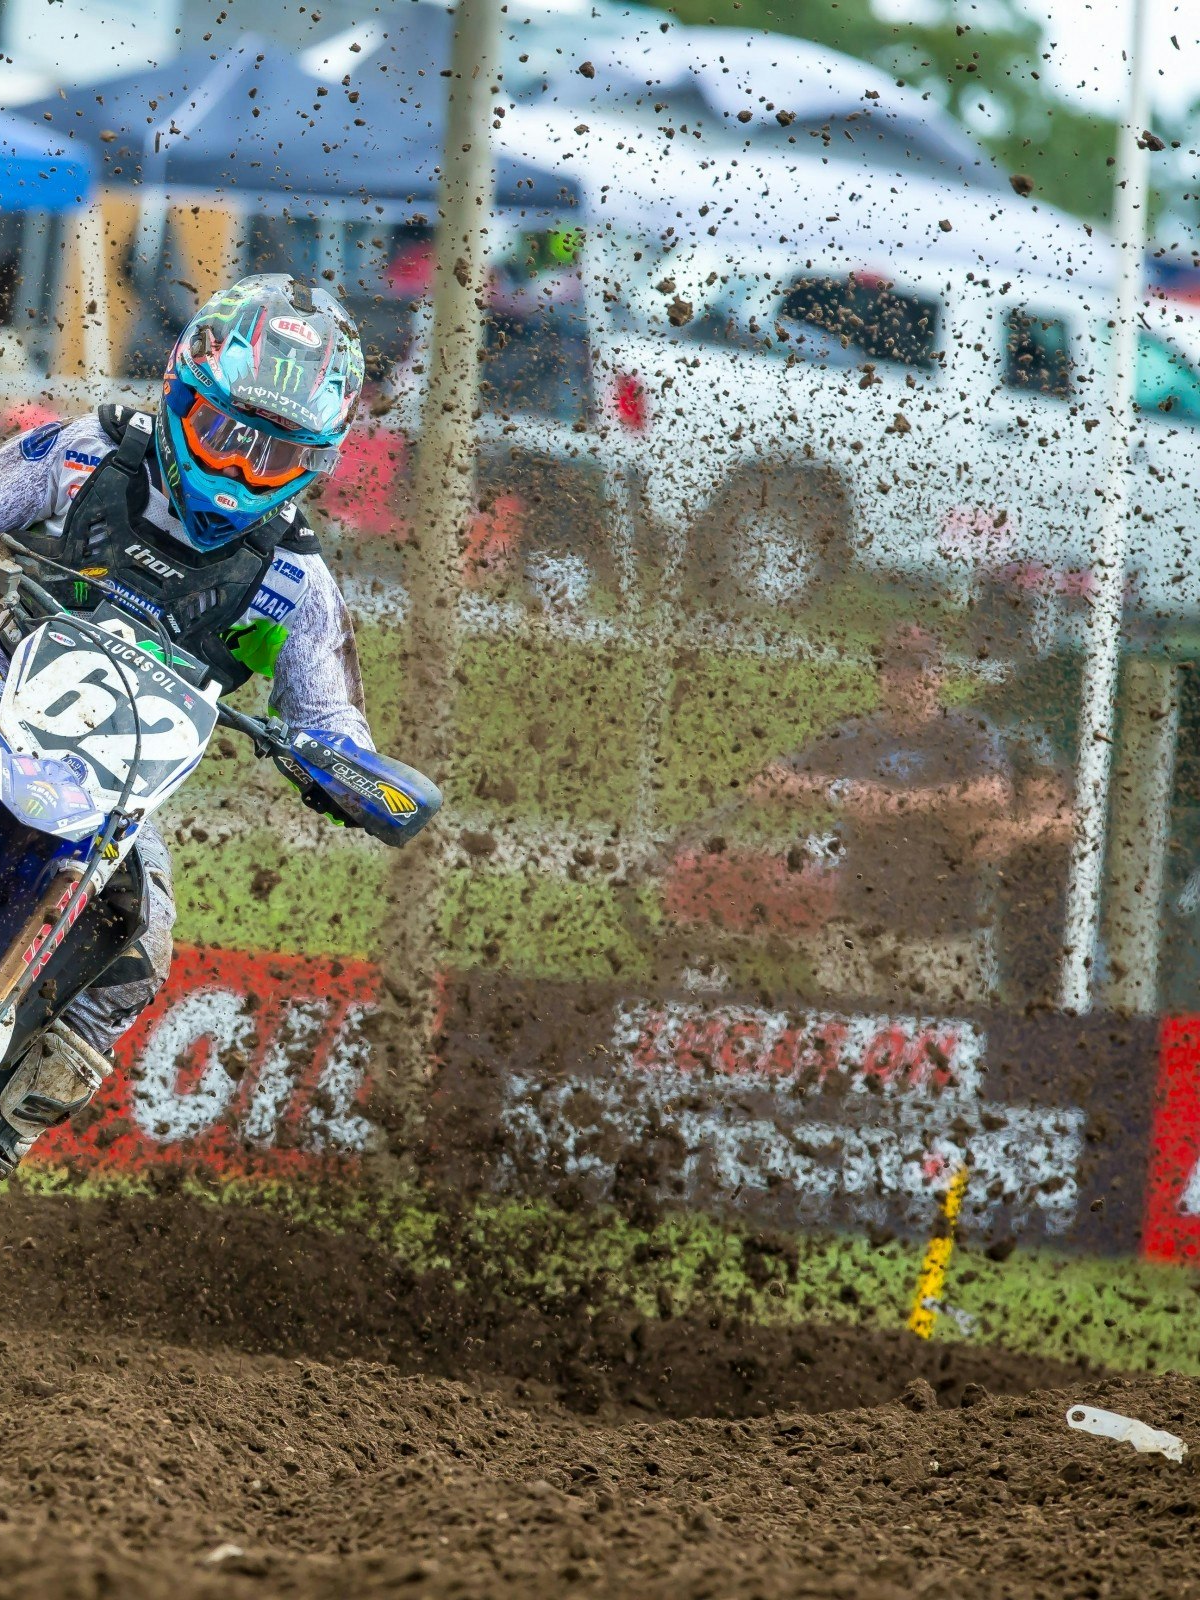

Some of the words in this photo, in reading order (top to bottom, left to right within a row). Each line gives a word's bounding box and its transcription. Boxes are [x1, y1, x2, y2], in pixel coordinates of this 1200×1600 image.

[278, 320, 315, 342] BELL
[216, 495, 236, 508] BELL
[280, 569, 301, 585] RACING
[281, 561, 306, 580] PRO
[166, 613, 182, 634] THOR
[103, 639, 154, 672] LUCAS
[151, 670, 178, 694] OIL
[17, 652, 200, 796] 62
[332, 762, 385, 800] CYCRA
[131, 986, 376, 1154] OIL
